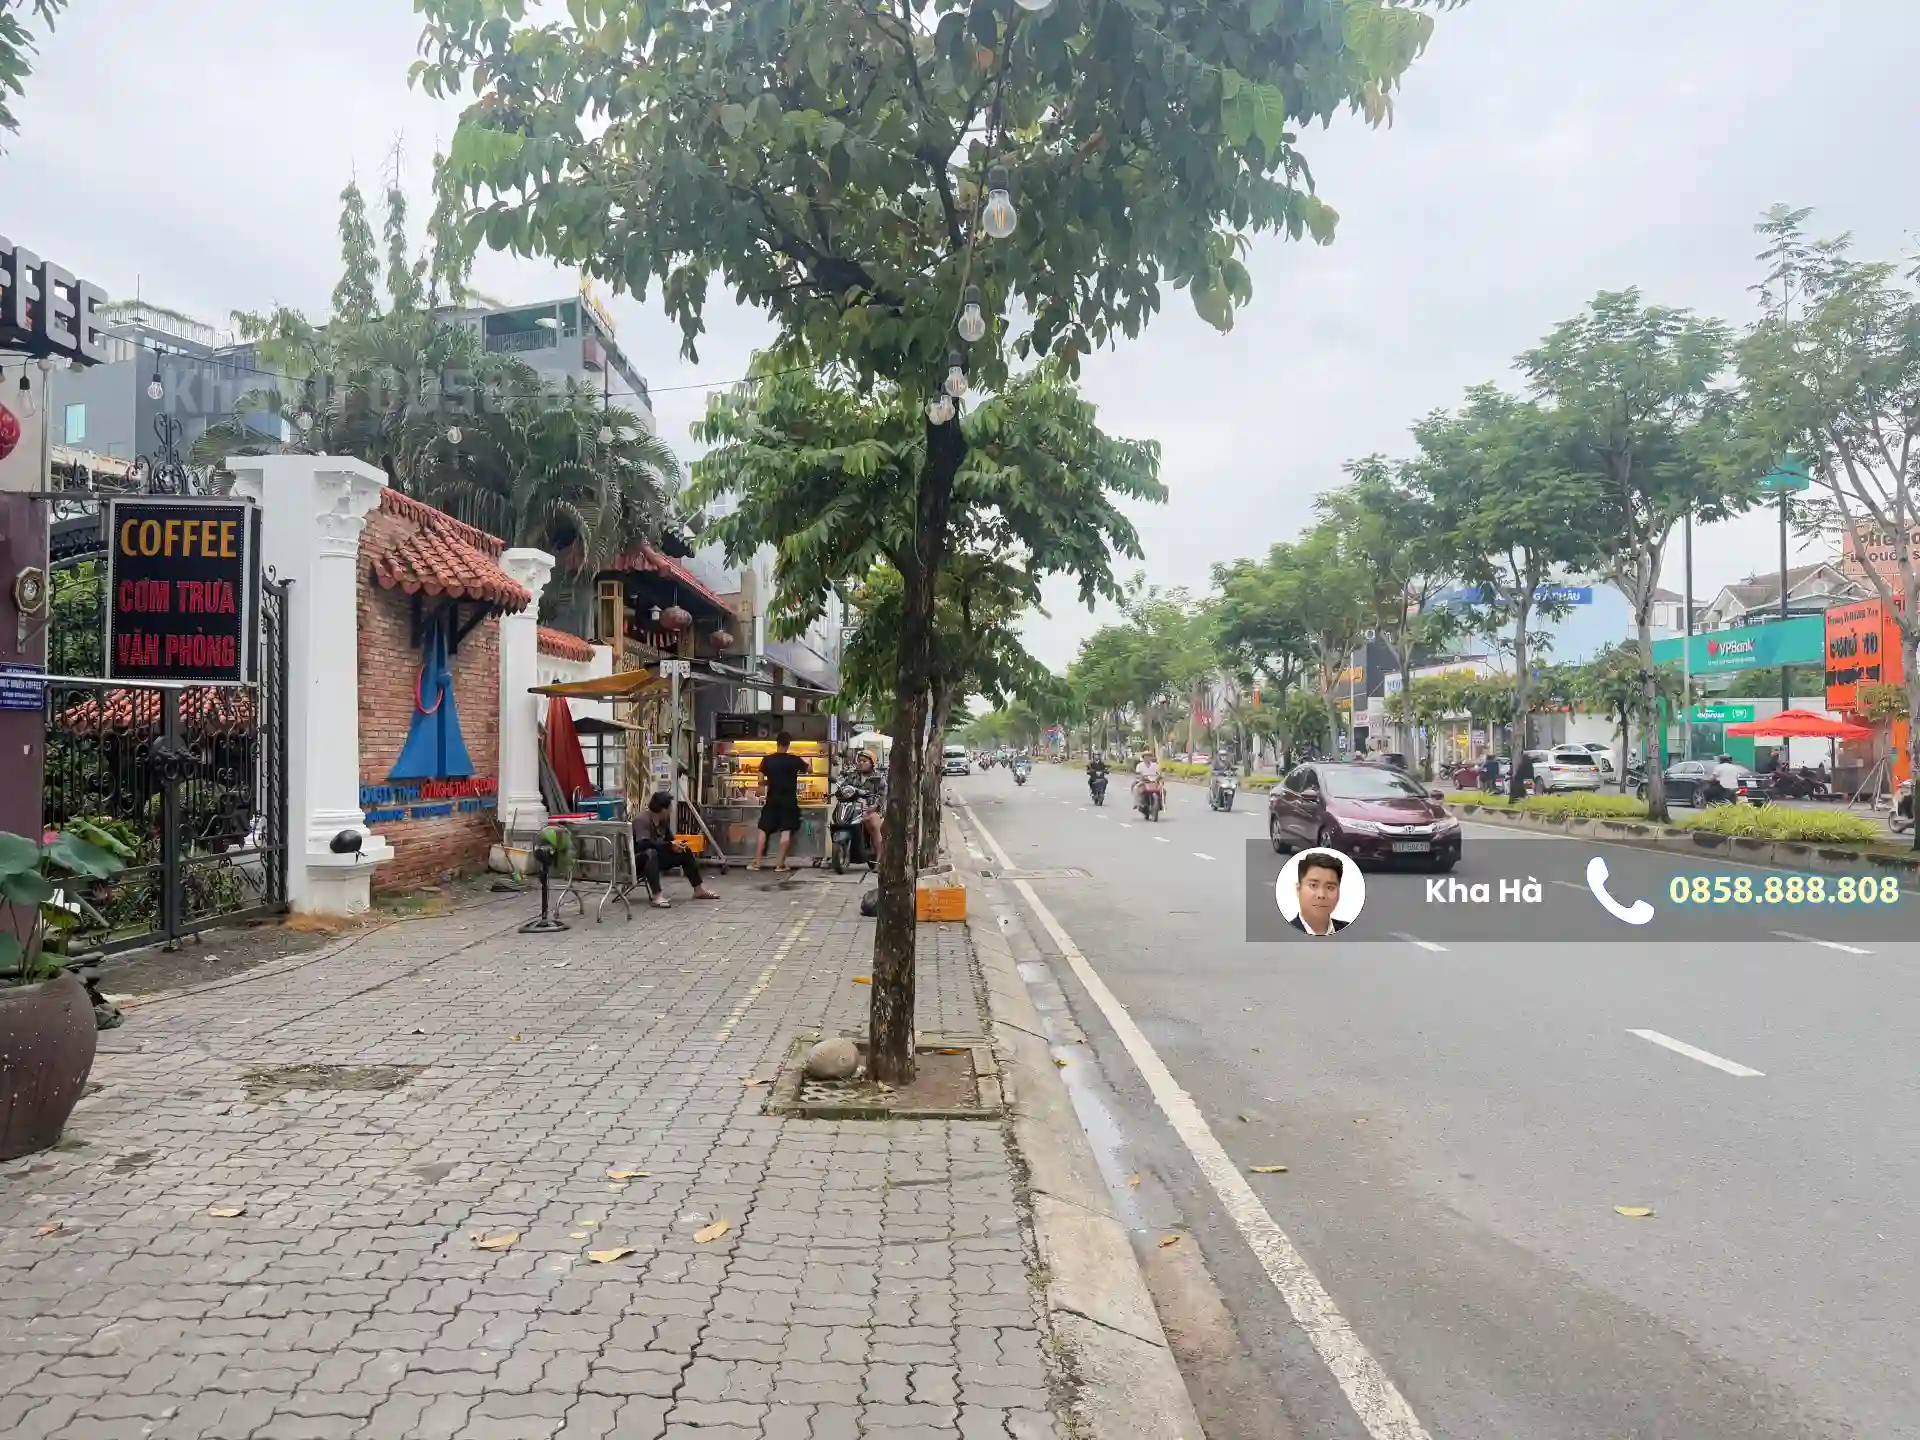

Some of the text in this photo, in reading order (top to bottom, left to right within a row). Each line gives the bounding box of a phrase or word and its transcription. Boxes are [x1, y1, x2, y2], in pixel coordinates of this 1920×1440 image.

[121, 519, 237, 558] COFFEE
[119, 577, 236, 614] CƠM TRƯA
[117, 626, 235, 667] VĂN PHÒNG
[1719, 637, 1755, 656] VPBank
